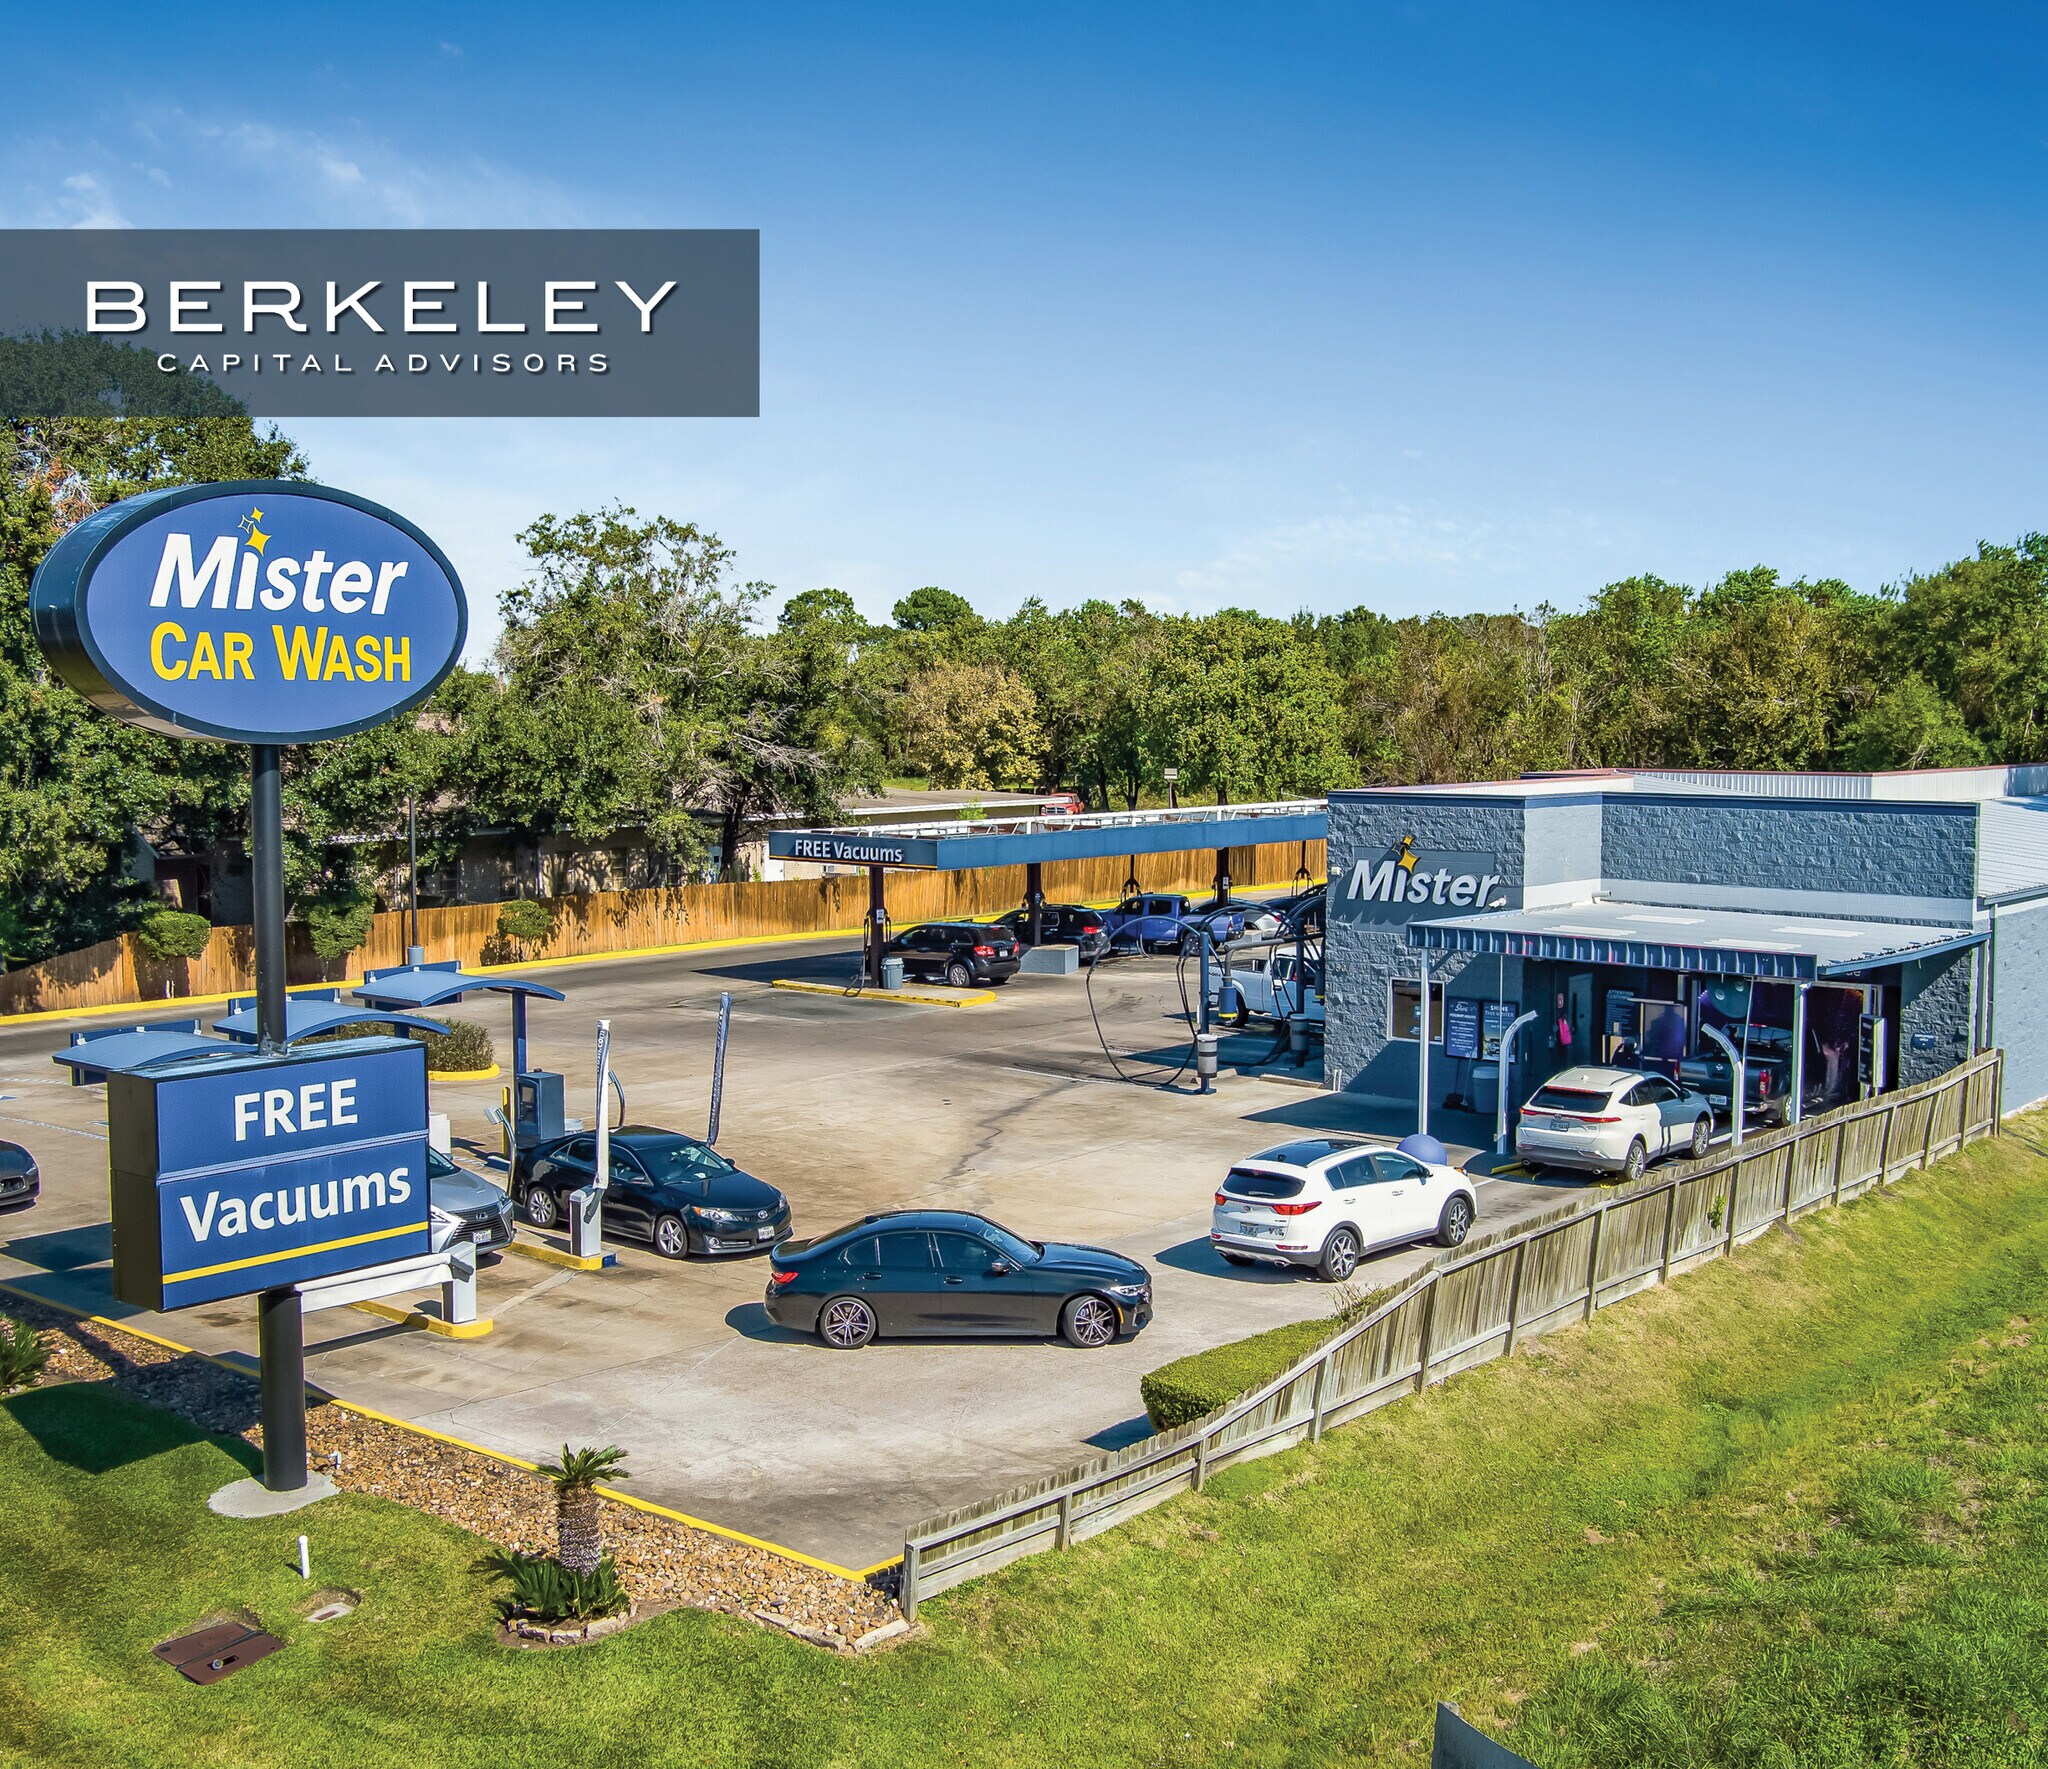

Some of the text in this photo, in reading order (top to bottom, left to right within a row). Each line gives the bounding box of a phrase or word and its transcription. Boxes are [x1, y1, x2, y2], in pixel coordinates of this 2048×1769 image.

[149, 531, 409, 615] Mister
[151, 622, 411, 682] CAR WASH
[795, 839, 903, 862] FREE Vacuums
[1346, 858, 1501, 908] Mister
[234, 1078, 358, 1142] FREE
[179, 1167, 412, 1242] Vacuums
